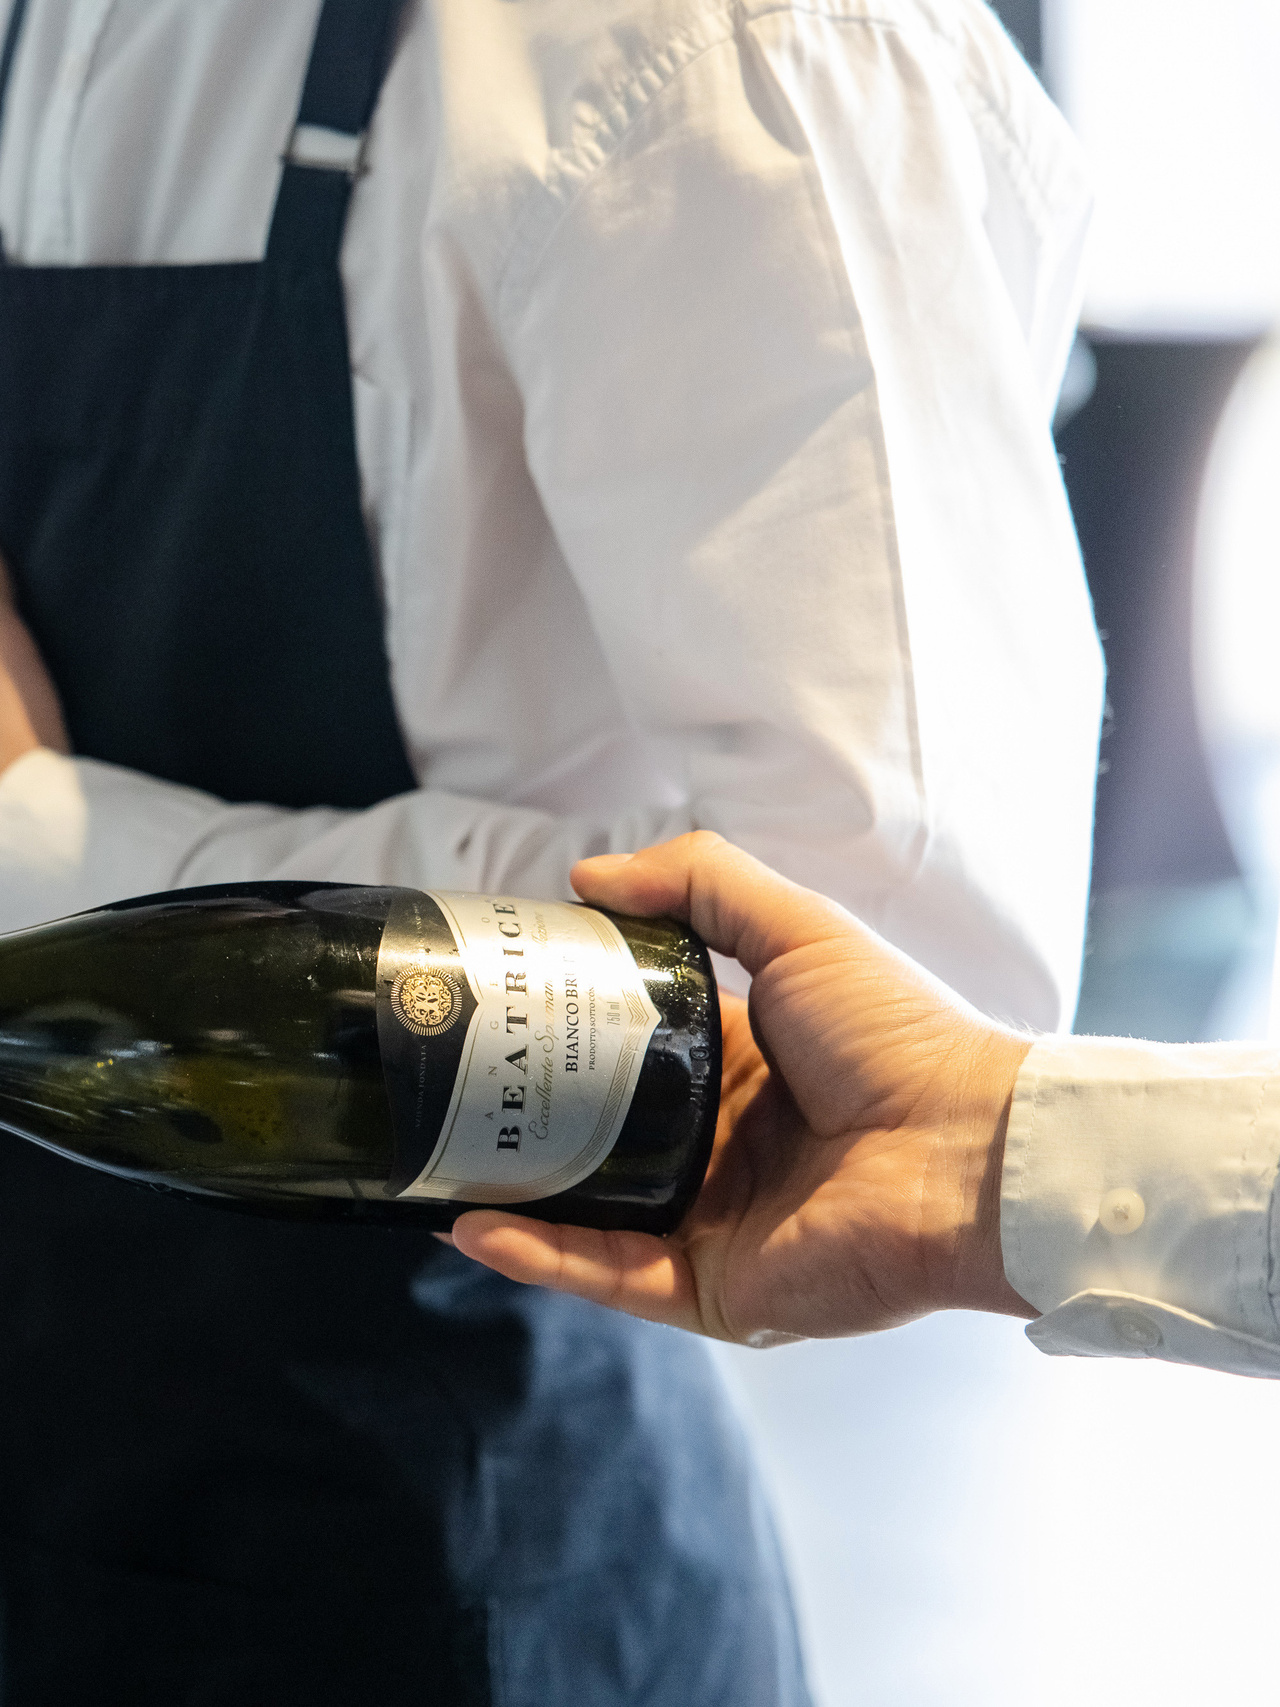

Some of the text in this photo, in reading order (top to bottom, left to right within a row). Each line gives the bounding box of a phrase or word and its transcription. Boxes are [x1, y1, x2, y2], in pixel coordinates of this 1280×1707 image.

[480, 916, 500, 1120] ANGEO
[492, 901, 530, 1152] BEATRICE
[565, 1001, 579, 1073] BIANCO
[588, 1002, 596, 1026] SOTTO
[588, 1026, 597, 1070] PRODOTTO
[606, 1000, 621, 1025] 750 ml
[527, 1055, 554, 1140] Eccellente
